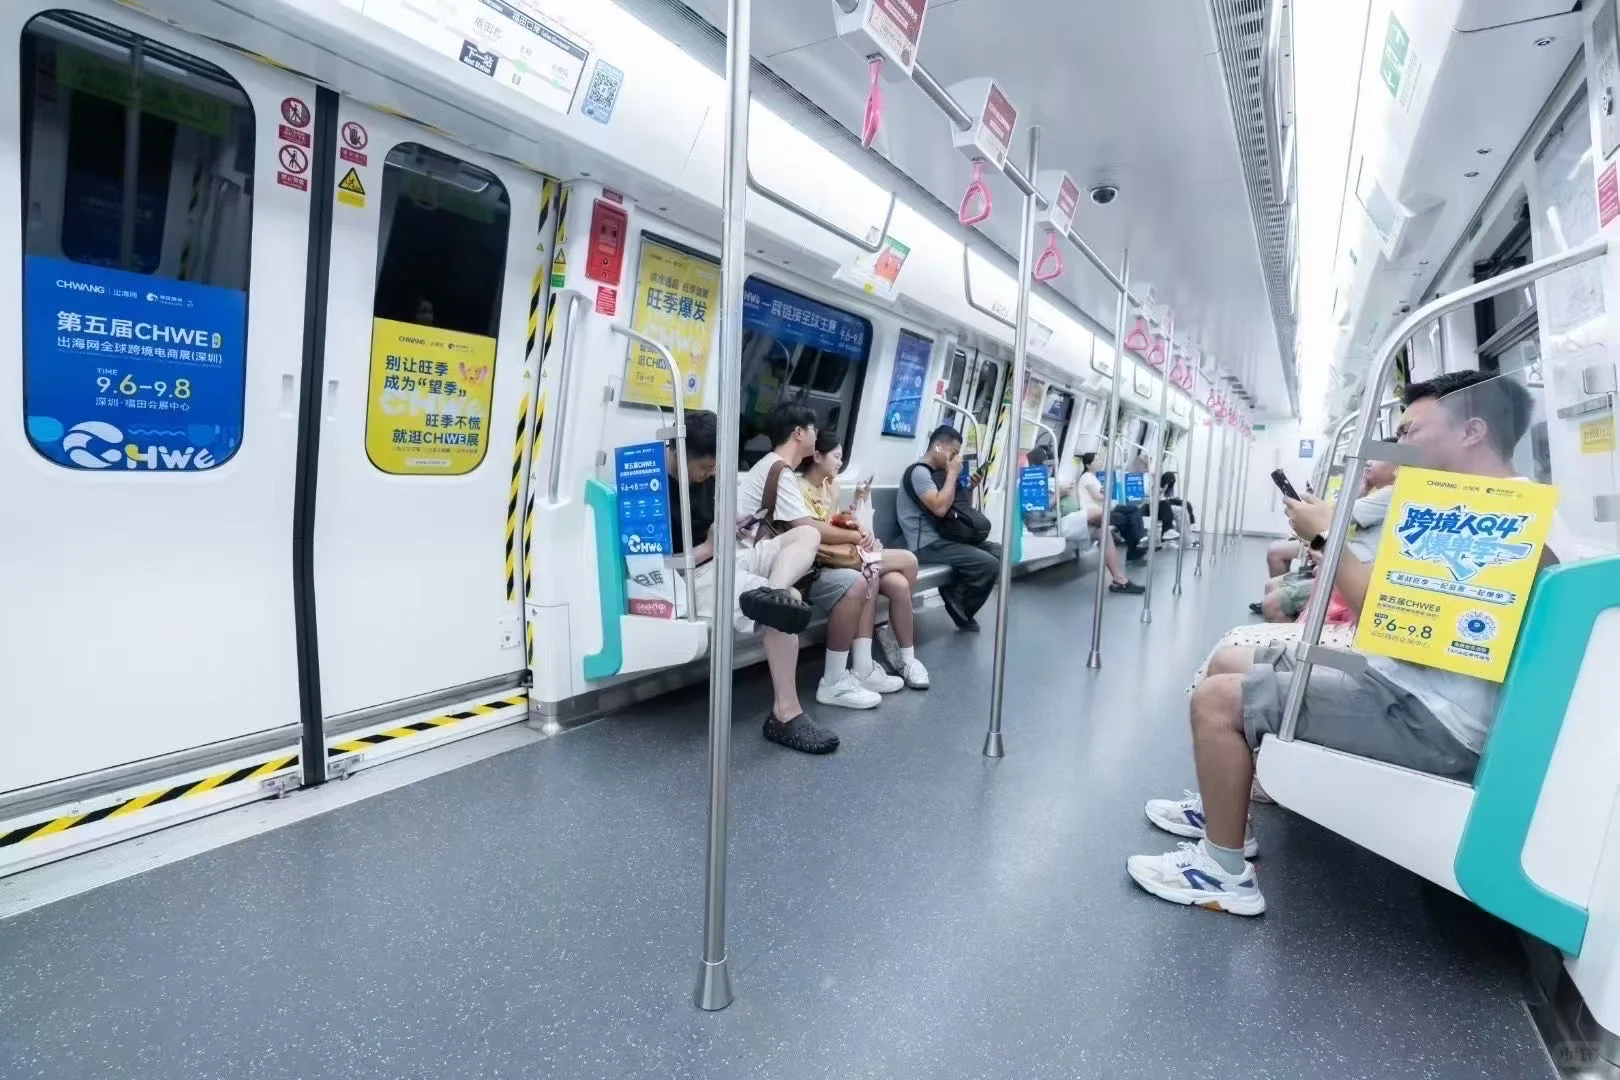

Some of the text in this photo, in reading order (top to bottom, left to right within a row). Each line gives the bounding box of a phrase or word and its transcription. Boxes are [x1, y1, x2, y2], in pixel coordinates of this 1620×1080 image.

[467, 45, 494, 68] 下一站
[56, 279, 105, 294] CHWANG
[647, 286, 708, 322] 旺季爆发
[761, 299, 838, 334] 一展链接全球生意
[56, 310, 209, 348] 第五届CHWE
[57, 336, 222, 365] 出海网全球跨境电商展(深圳)
[97, 367, 118, 376] TIME
[385, 355, 449, 376] 别让旺季
[96, 374, 191, 399] 9.6-9.8
[425, 413, 481, 430] 旺季不慌
[392, 428, 479, 447] 就逛CHWE展
[1398, 508, 1520, 545] 跨境人Q4
[1379, 594, 1436, 612] 第五届CHWE
[1374, 619, 1433, 639] 9.6-9.8
